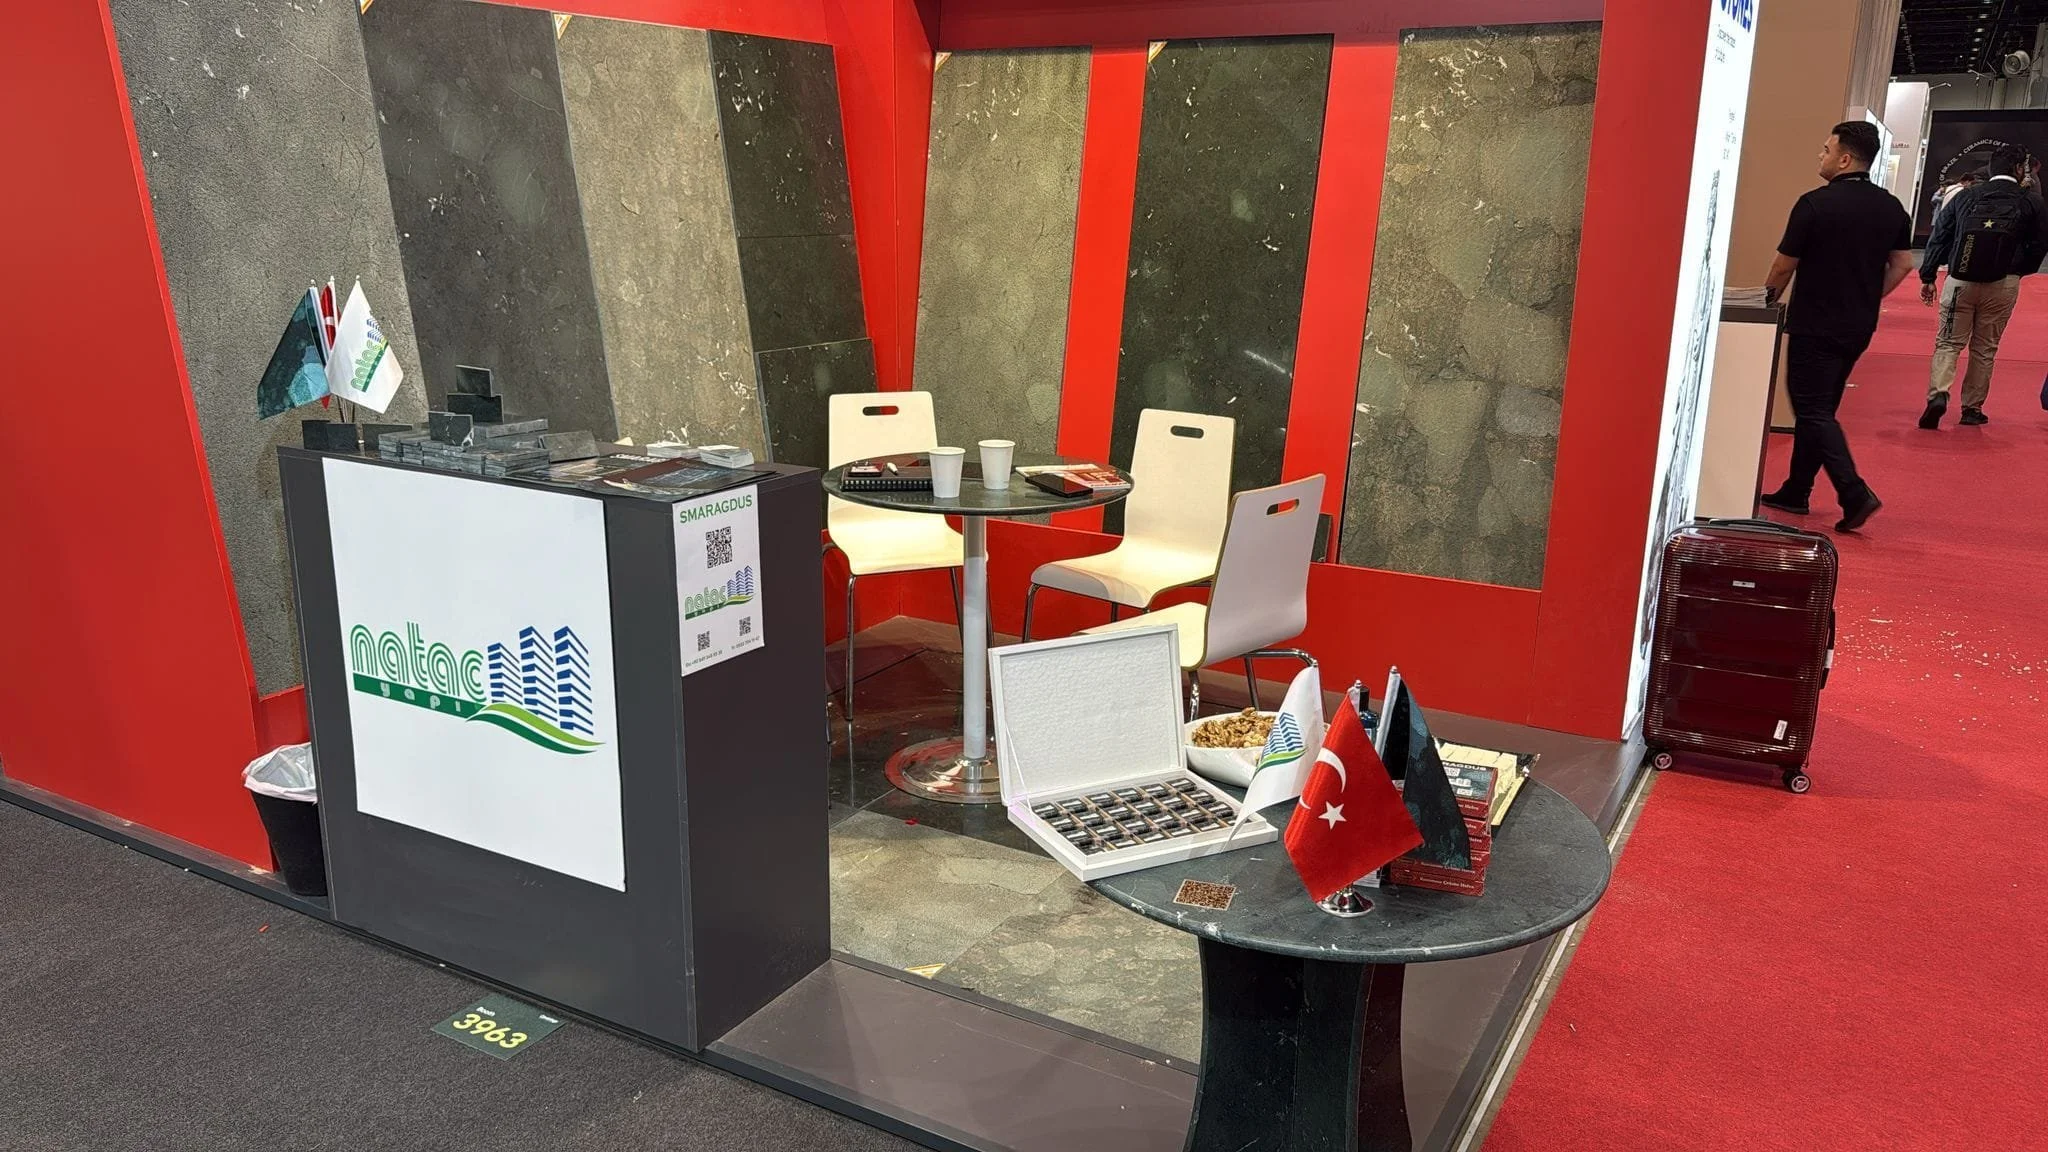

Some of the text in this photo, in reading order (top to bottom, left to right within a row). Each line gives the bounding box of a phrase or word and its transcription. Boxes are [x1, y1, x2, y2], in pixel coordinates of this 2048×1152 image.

[679, 494, 753, 524] SMARAGDUS
[350, 621, 487, 703] natac
[452, 1013, 528, 1049] 3963
